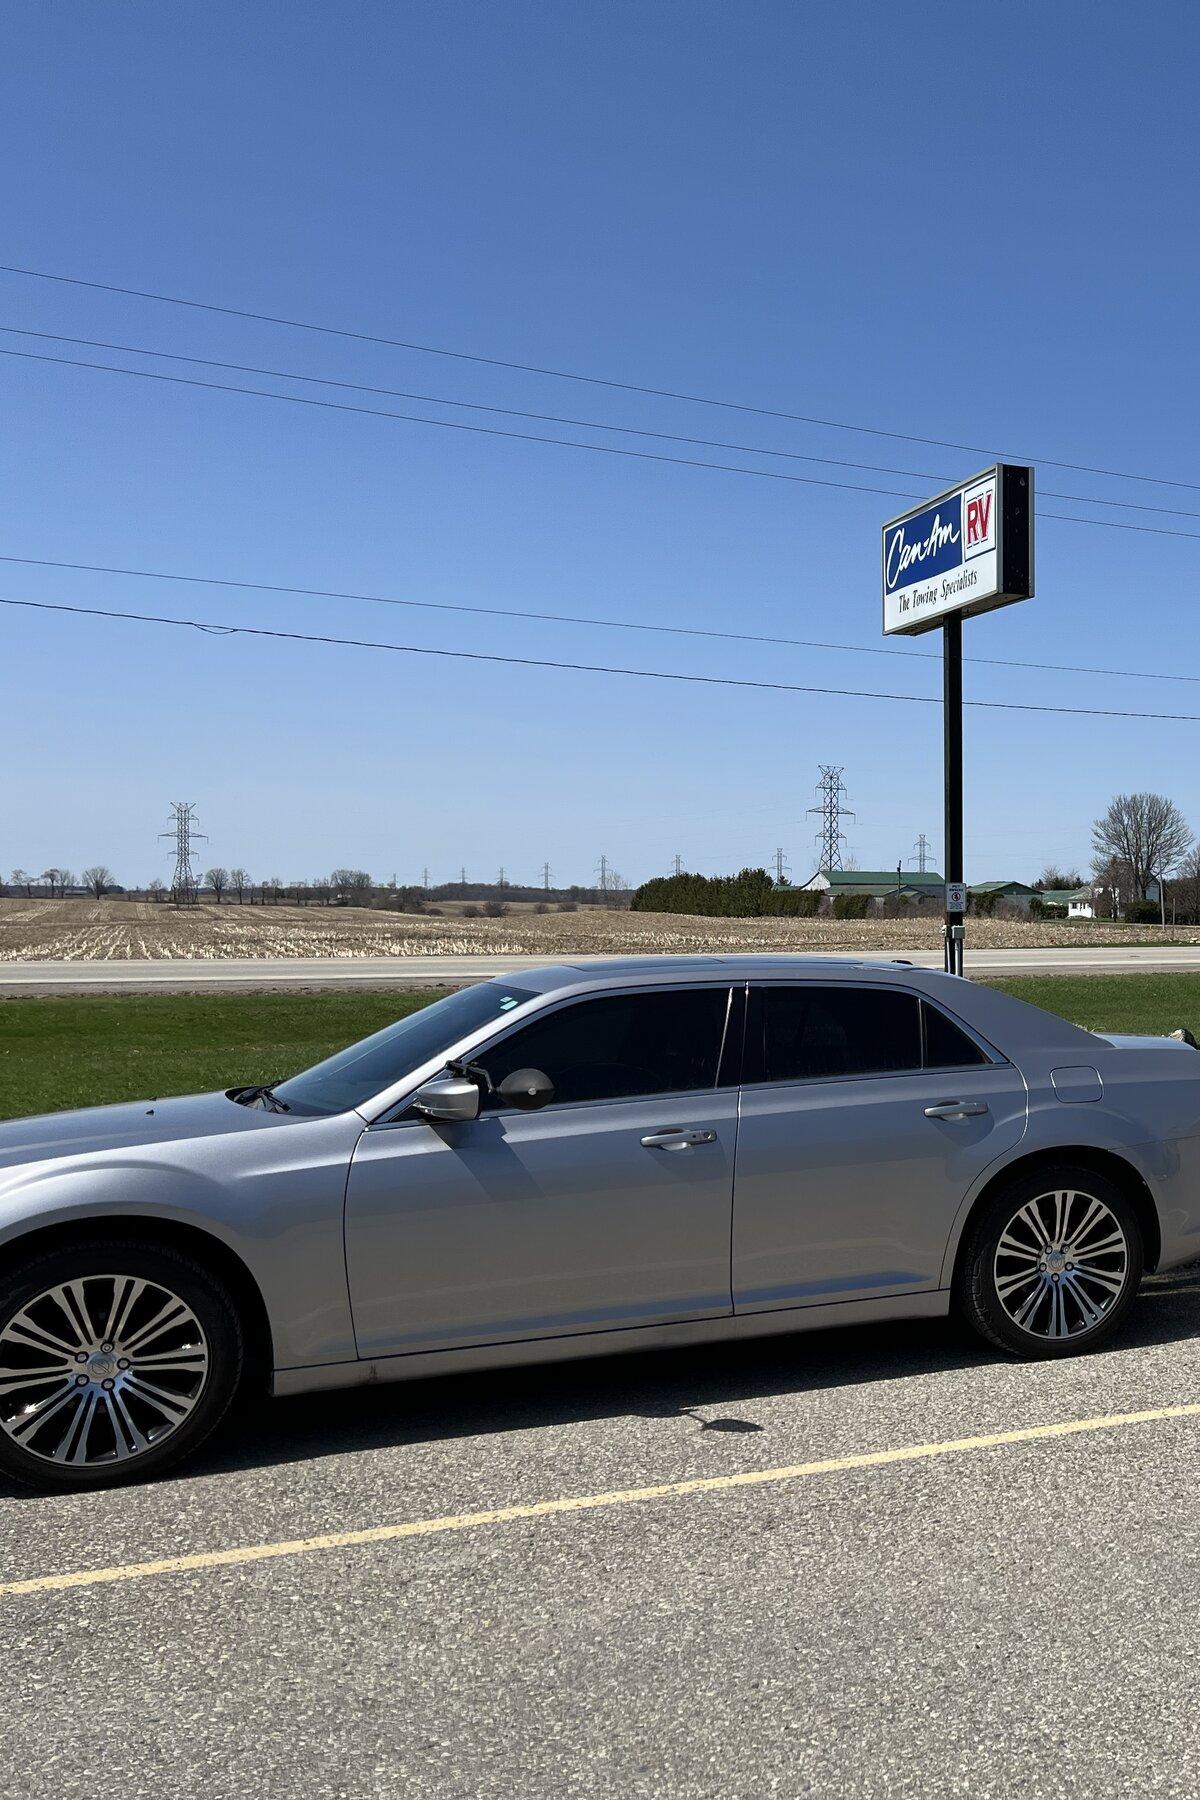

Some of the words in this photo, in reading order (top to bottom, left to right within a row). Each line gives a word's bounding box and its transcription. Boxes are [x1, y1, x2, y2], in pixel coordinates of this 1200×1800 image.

[966, 492, 993, 547] RV
[886, 514, 961, 589] Can-Am
[899, 594, 910, 613] The
[912, 586, 939, 606] Towing
[940, 570, 978, 600] Specialists
